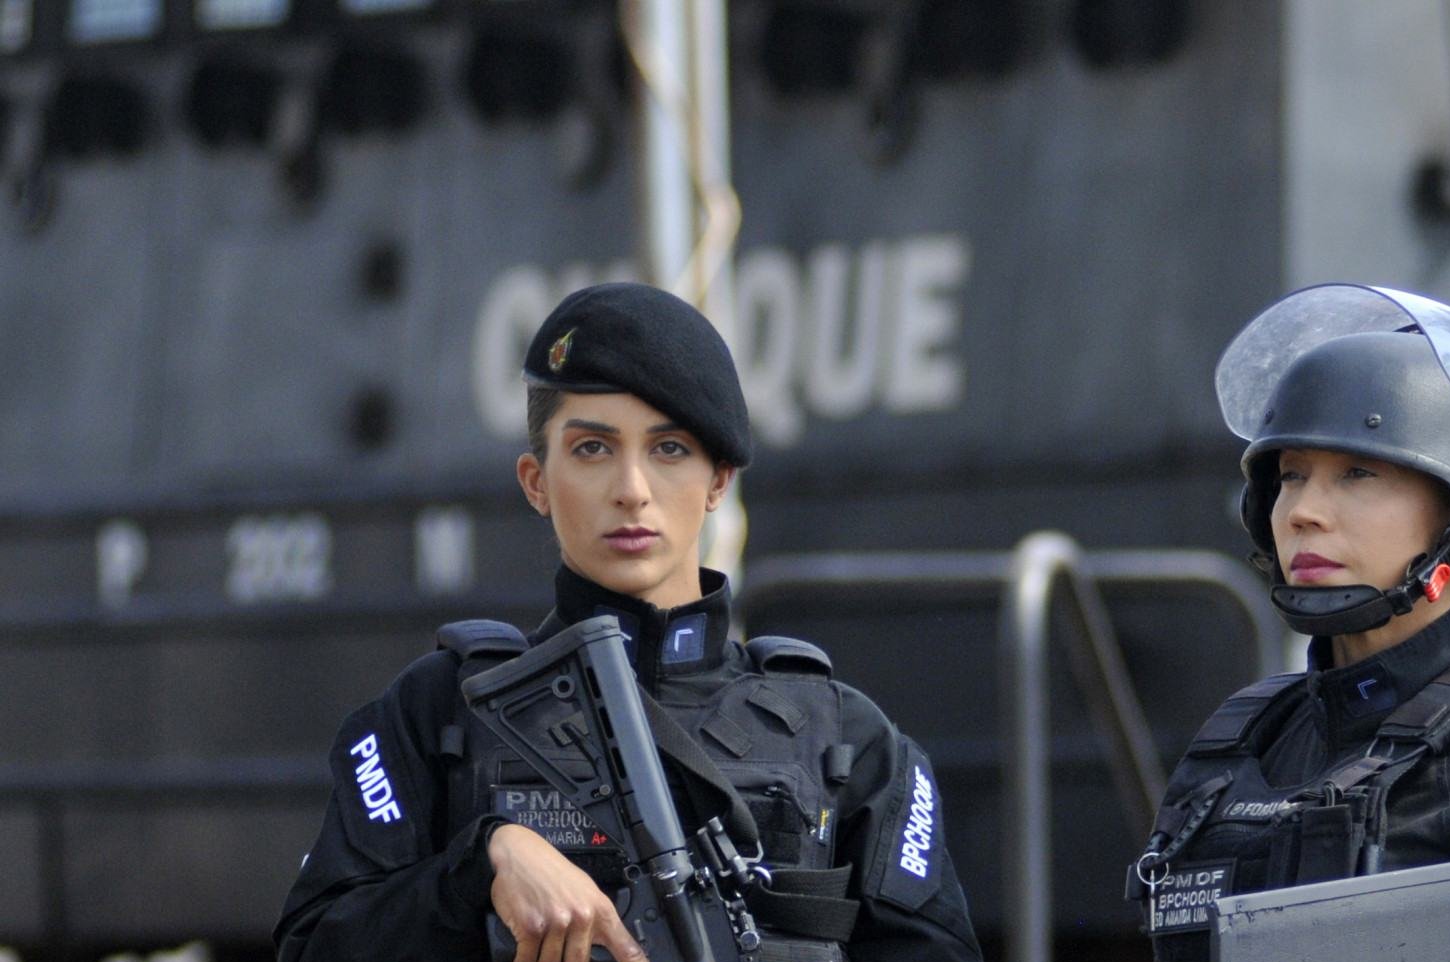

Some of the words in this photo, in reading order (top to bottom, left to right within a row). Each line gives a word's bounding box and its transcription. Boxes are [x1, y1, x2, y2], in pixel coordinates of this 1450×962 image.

[475, 233, 967, 444] CQUE
[350, 733, 402, 824] PMDF
[518, 811, 597, 831] BPCHOQU
[590, 832, 608, 846] A+
[1158, 887, 1221, 910] BPCHOQUE
